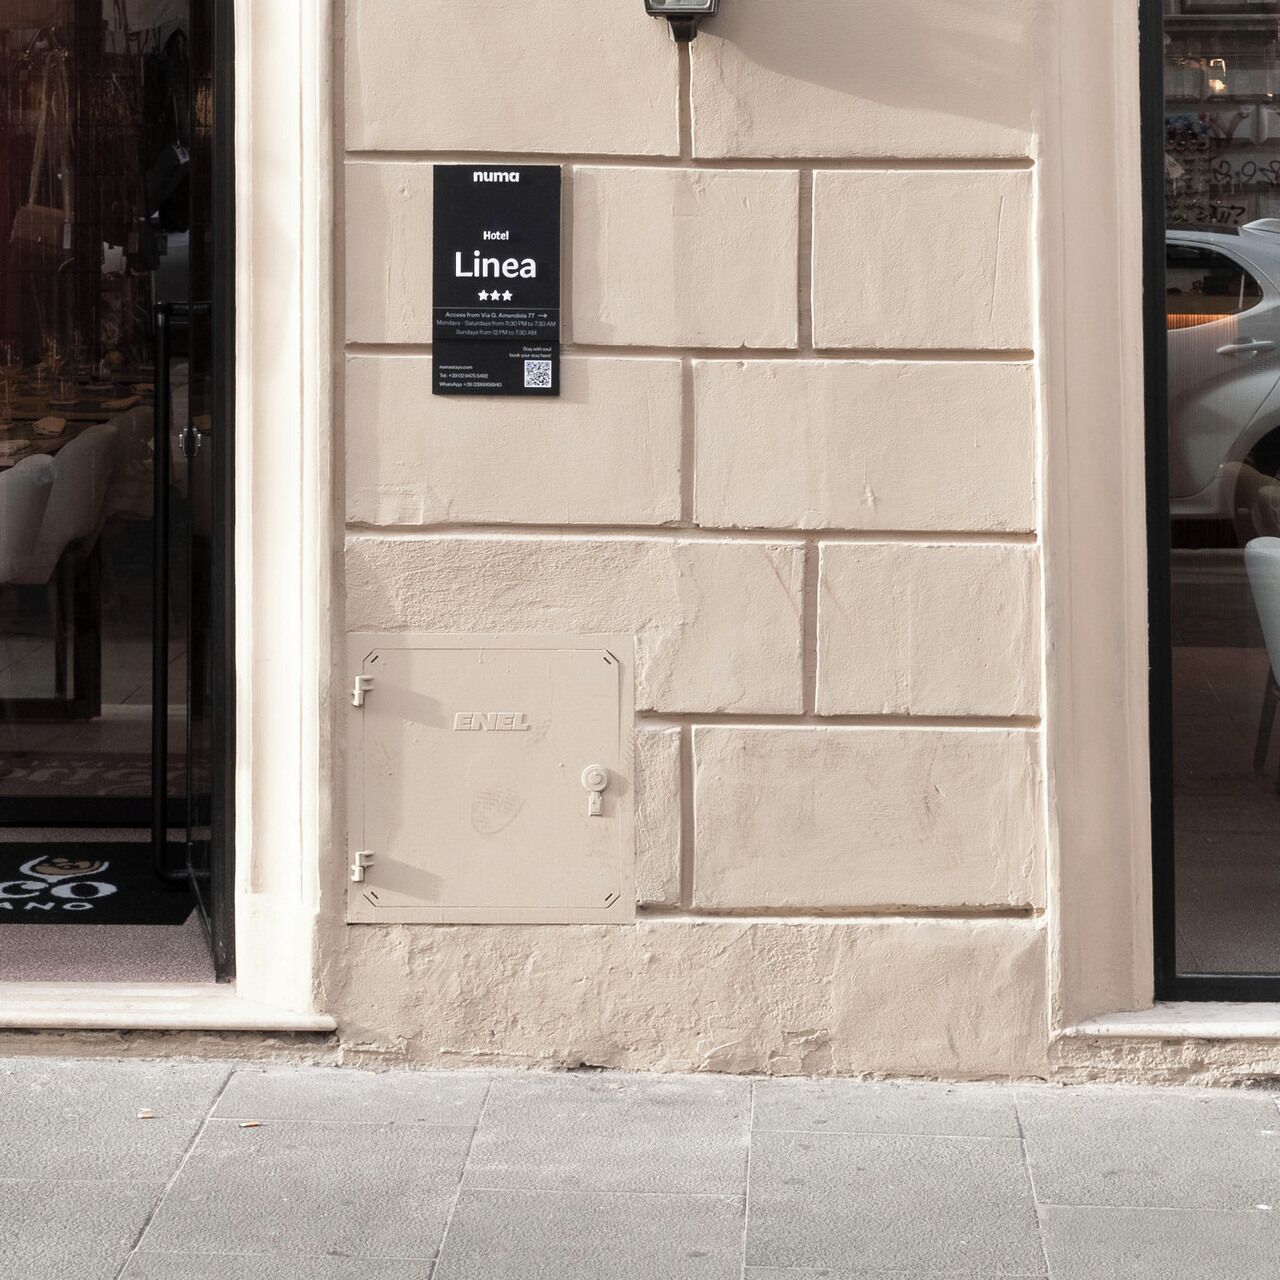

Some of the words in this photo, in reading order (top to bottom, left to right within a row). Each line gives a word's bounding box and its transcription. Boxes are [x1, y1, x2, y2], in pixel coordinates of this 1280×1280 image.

[473, 170, 520, 183] numa
[483, 230, 509, 241] Hotel
[455, 249, 537, 279] Linea
[453, 712, 533, 732] ENEL
